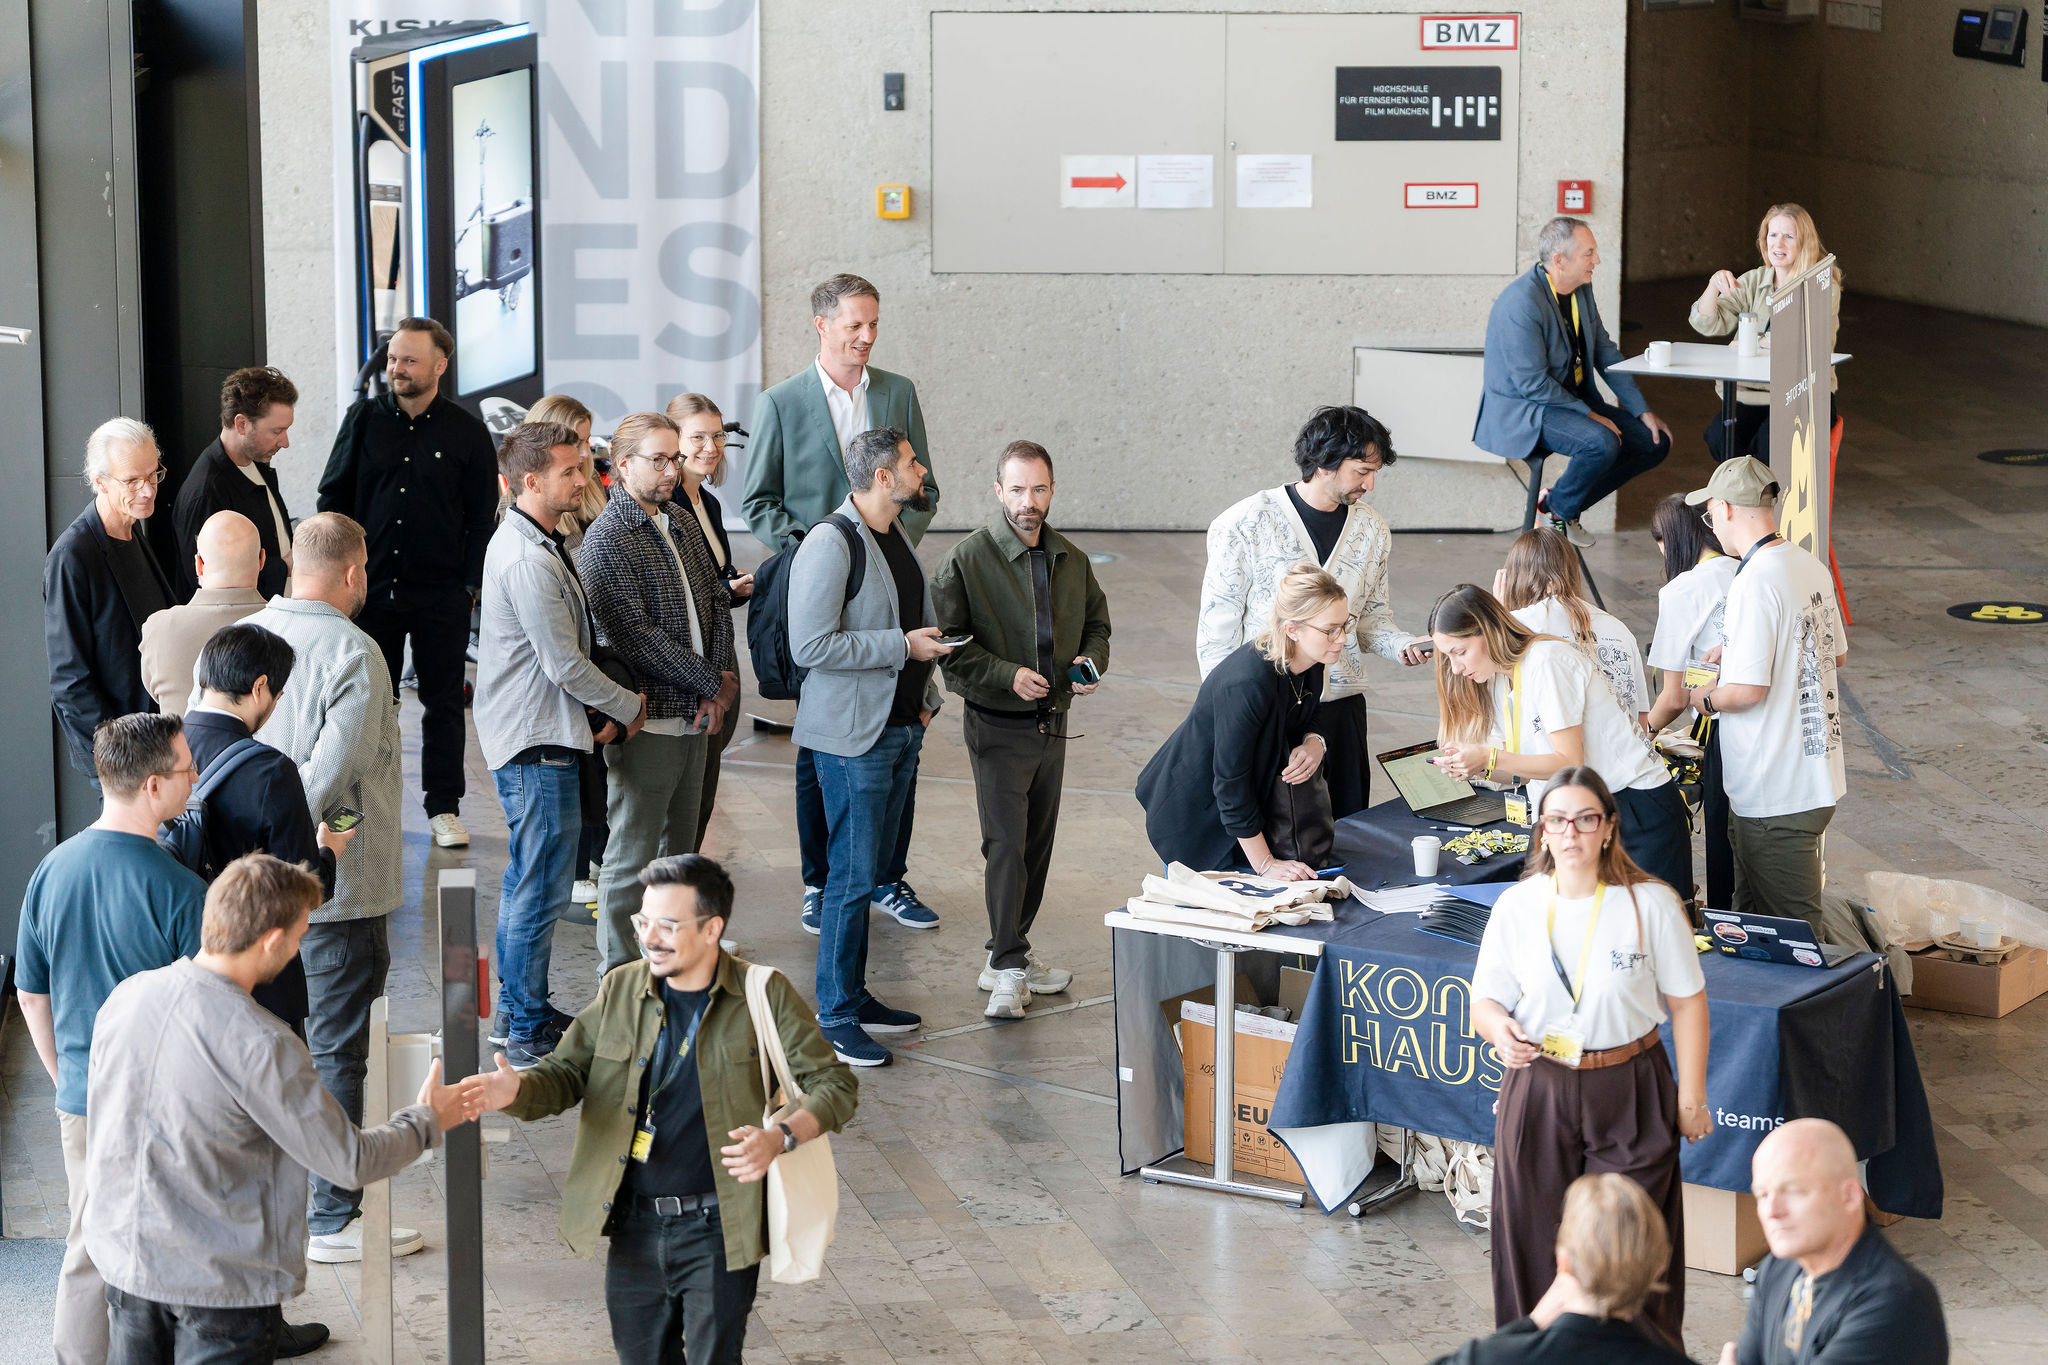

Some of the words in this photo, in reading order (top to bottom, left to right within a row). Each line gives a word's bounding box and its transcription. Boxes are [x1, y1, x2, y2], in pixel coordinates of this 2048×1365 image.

[1436, 22, 1501, 43] BMZ
[391, 70, 405, 119] FAST
[1373, 84, 1429, 93] HOCHSCHULE
[1339, 96, 1357, 104] FÜR
[1358, 96, 1409, 104] FERNSEHEN
[1410, 96, 1430, 104] UND
[1364, 107, 1386, 116] FILM
[1386, 107, 1430, 116] MÜNCHEN
[1426, 191, 1458, 200] BMZ
[1233, 1103, 1269, 1126] EU
[1716, 1107, 1785, 1131] teams
